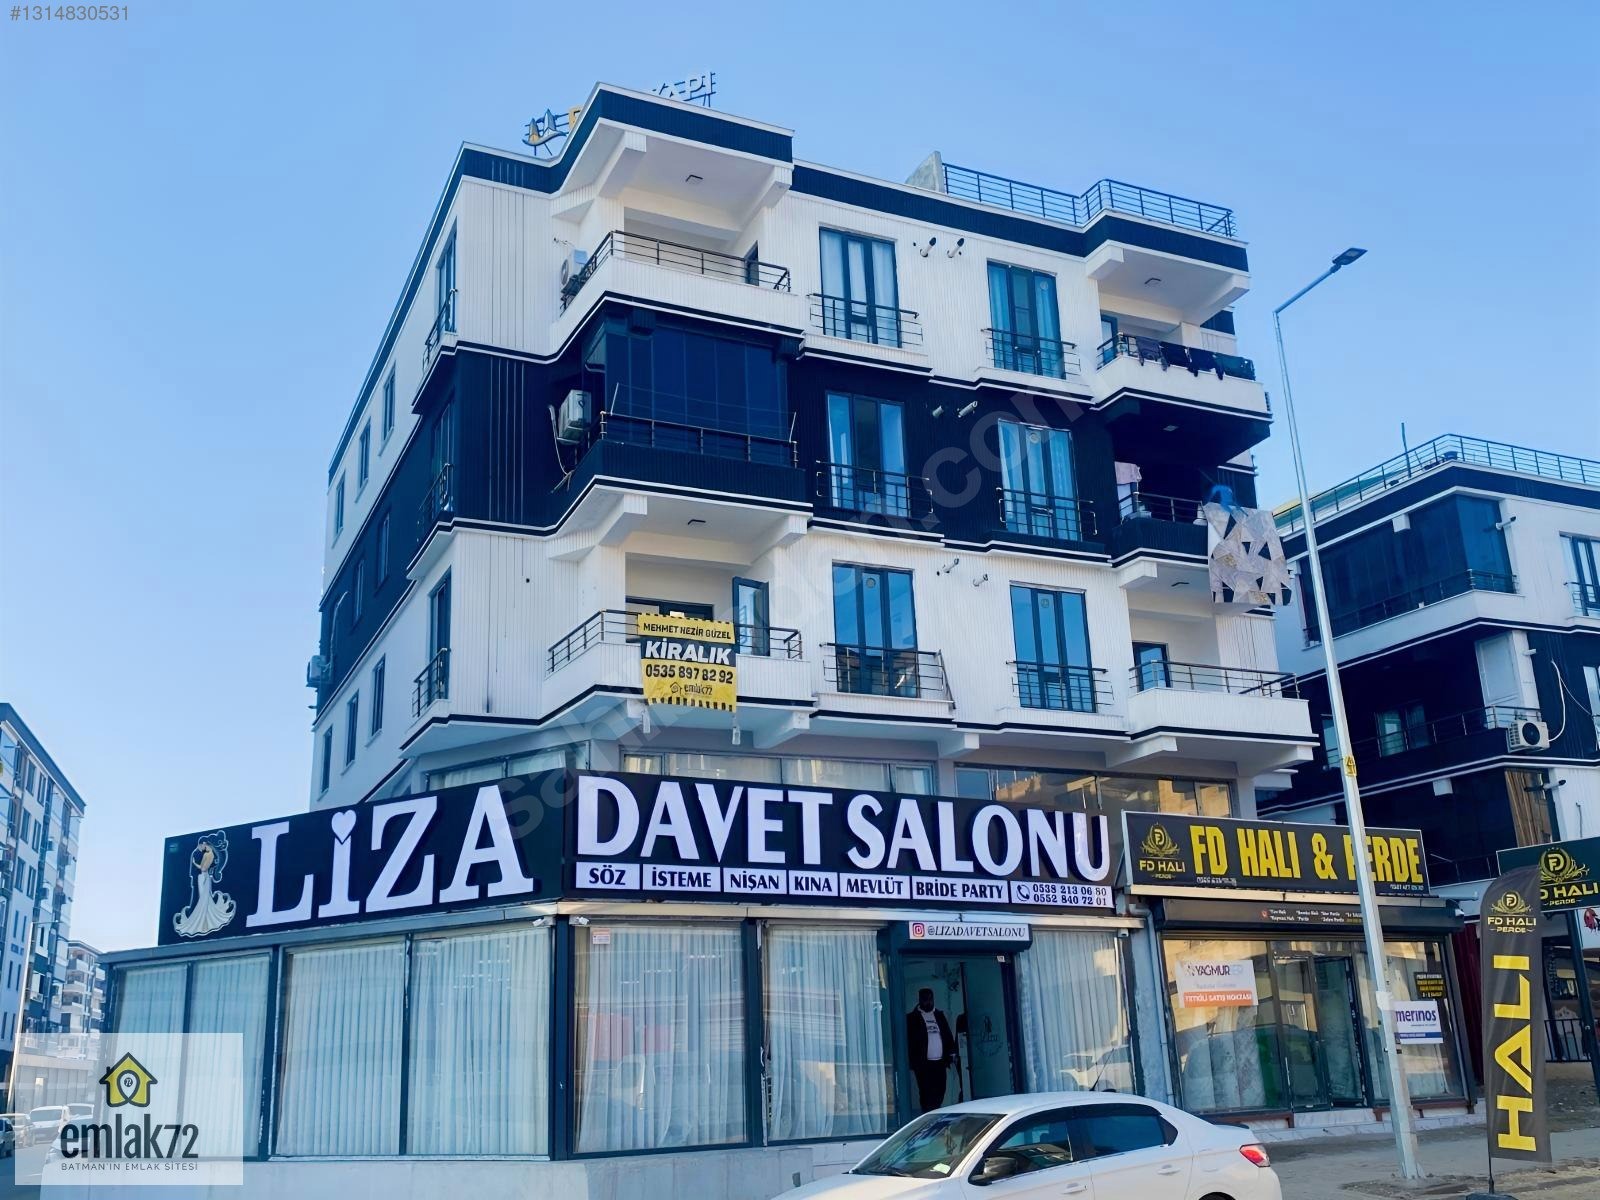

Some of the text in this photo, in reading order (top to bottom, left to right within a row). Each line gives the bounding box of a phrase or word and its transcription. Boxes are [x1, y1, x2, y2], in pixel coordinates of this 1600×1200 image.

[643, 622, 678, 634] MEHMET
[645, 638, 732, 665] KİRALIK
[645, 664, 734, 685] 0535 897 82 92
[577, 775, 1110, 882] DAVET SALONU
[1189, 824, 1229, 875] FD
[1236, 827, 1301, 879] HALI
[1311, 832, 1338, 880] &
[1139, 860, 1186, 873] FD HALI
[588, 864, 627, 886] SÖZ
[651, 866, 712, 888] İSTEME
[729, 869, 780, 891] NİŞAN
[793, 876, 833, 893] KINA
[846, 876, 904, 895] MEVLÜT
[961, 883, 1004, 899] PARTY
[1060, 885, 1078, 895] 213
[1553, 882, 1599, 898] HALI
[1033, 893, 1058, 903] 0552
[1061, 894, 1079, 905] 840
[1081, 896, 1094, 905] 72
[1487, 916, 1537, 926] FD HALI
[1396, 1009, 1437, 1022] merinos
[1493, 954, 1537, 1152] HALI
